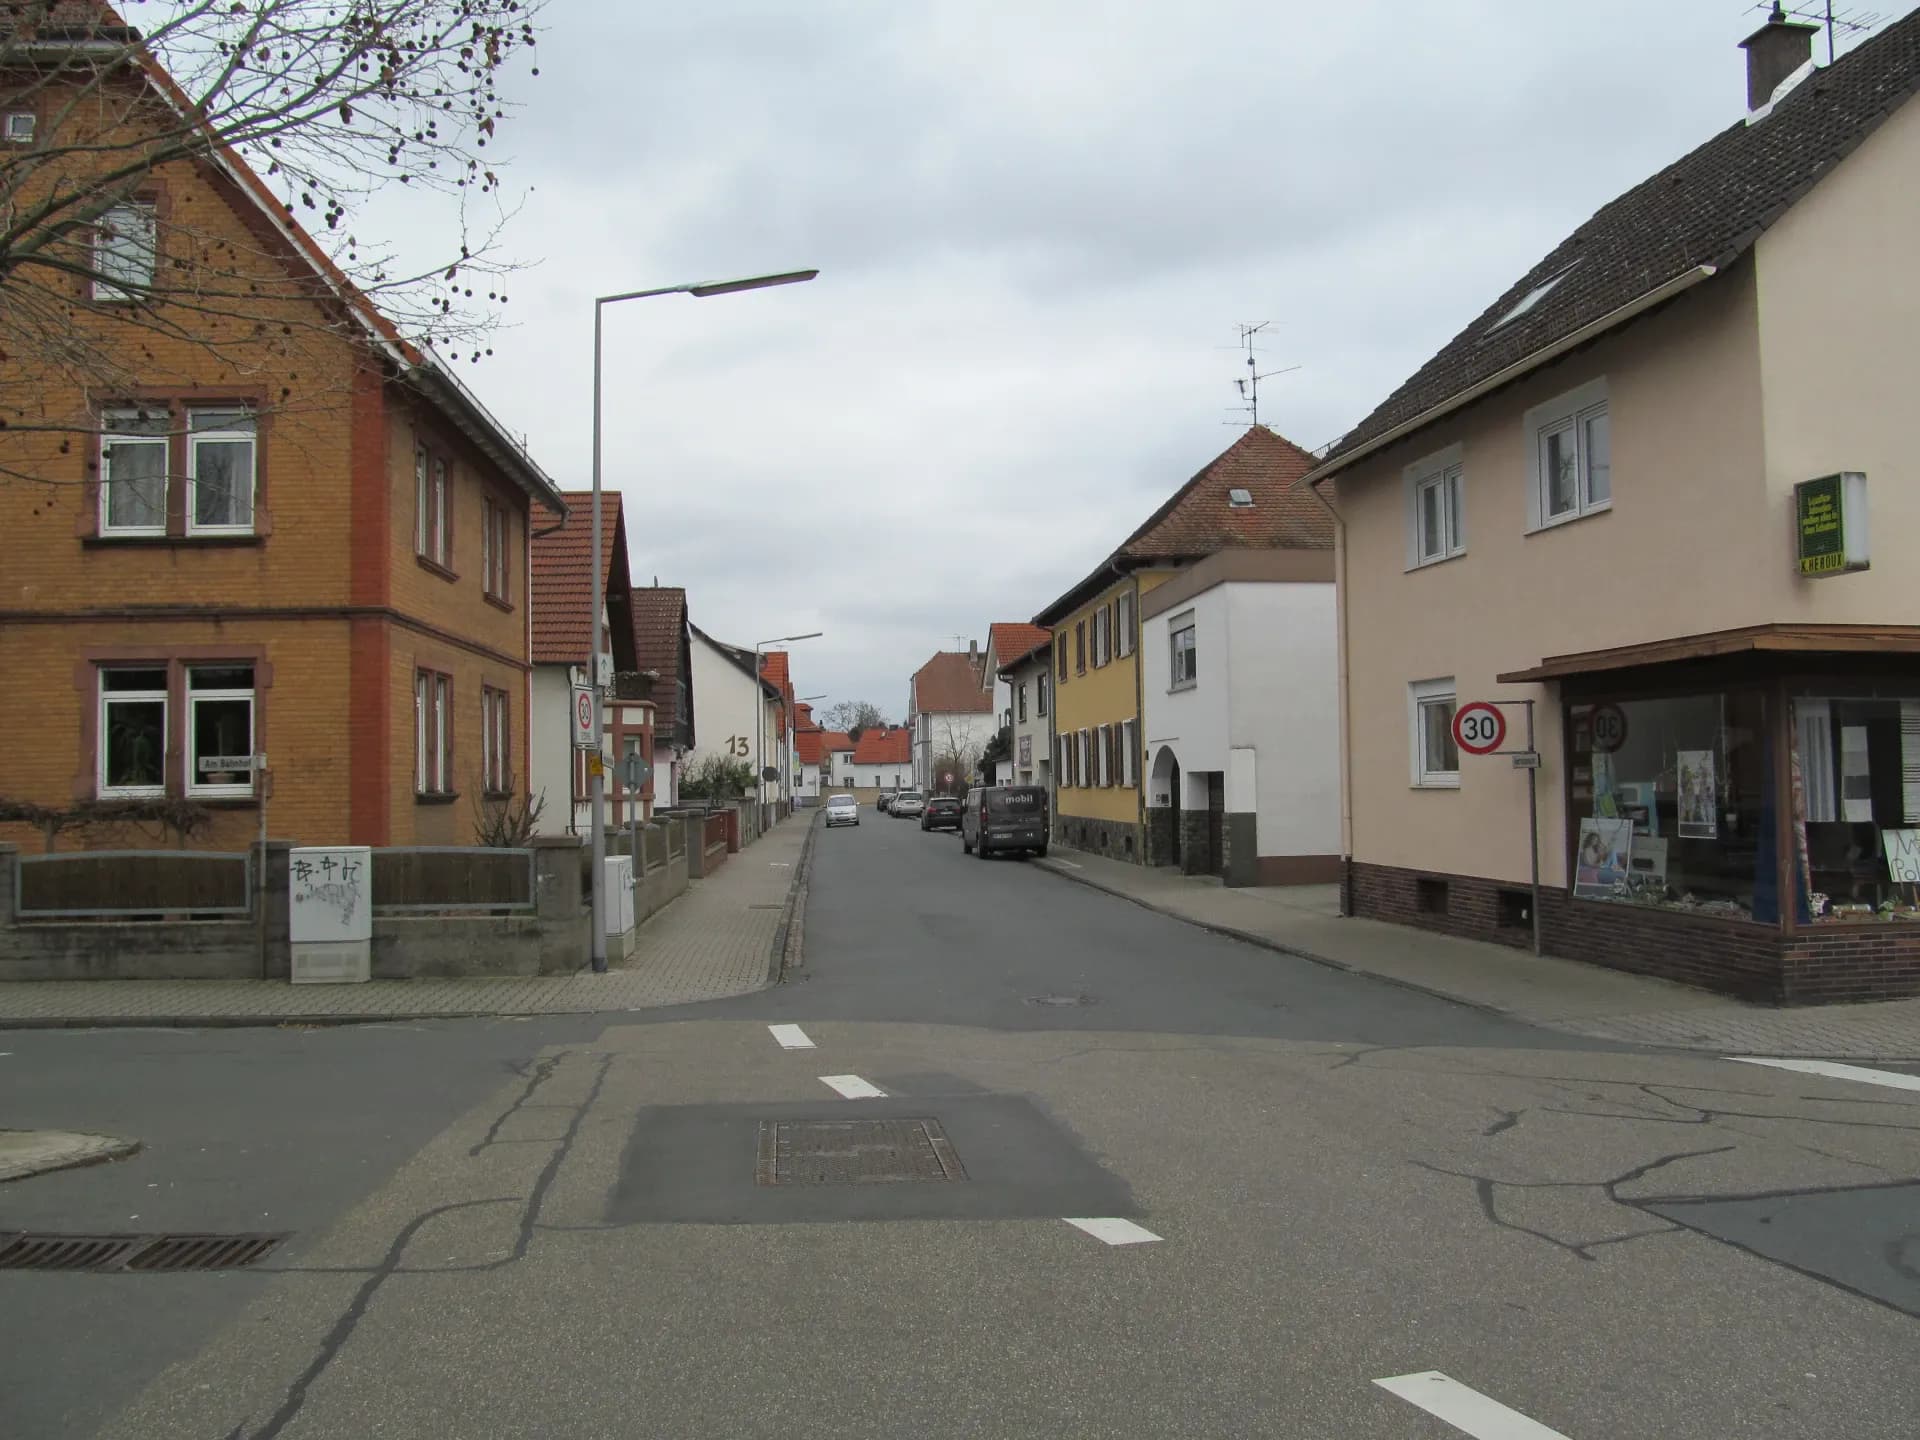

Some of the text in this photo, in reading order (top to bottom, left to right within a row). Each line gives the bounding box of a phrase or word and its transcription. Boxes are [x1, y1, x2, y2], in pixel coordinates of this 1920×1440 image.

[1464, 716, 1495, 740] 30
[725, 734, 749, 757] 13
[205, 759, 218, 768] Am
[1005, 794, 1033, 804] mobil
